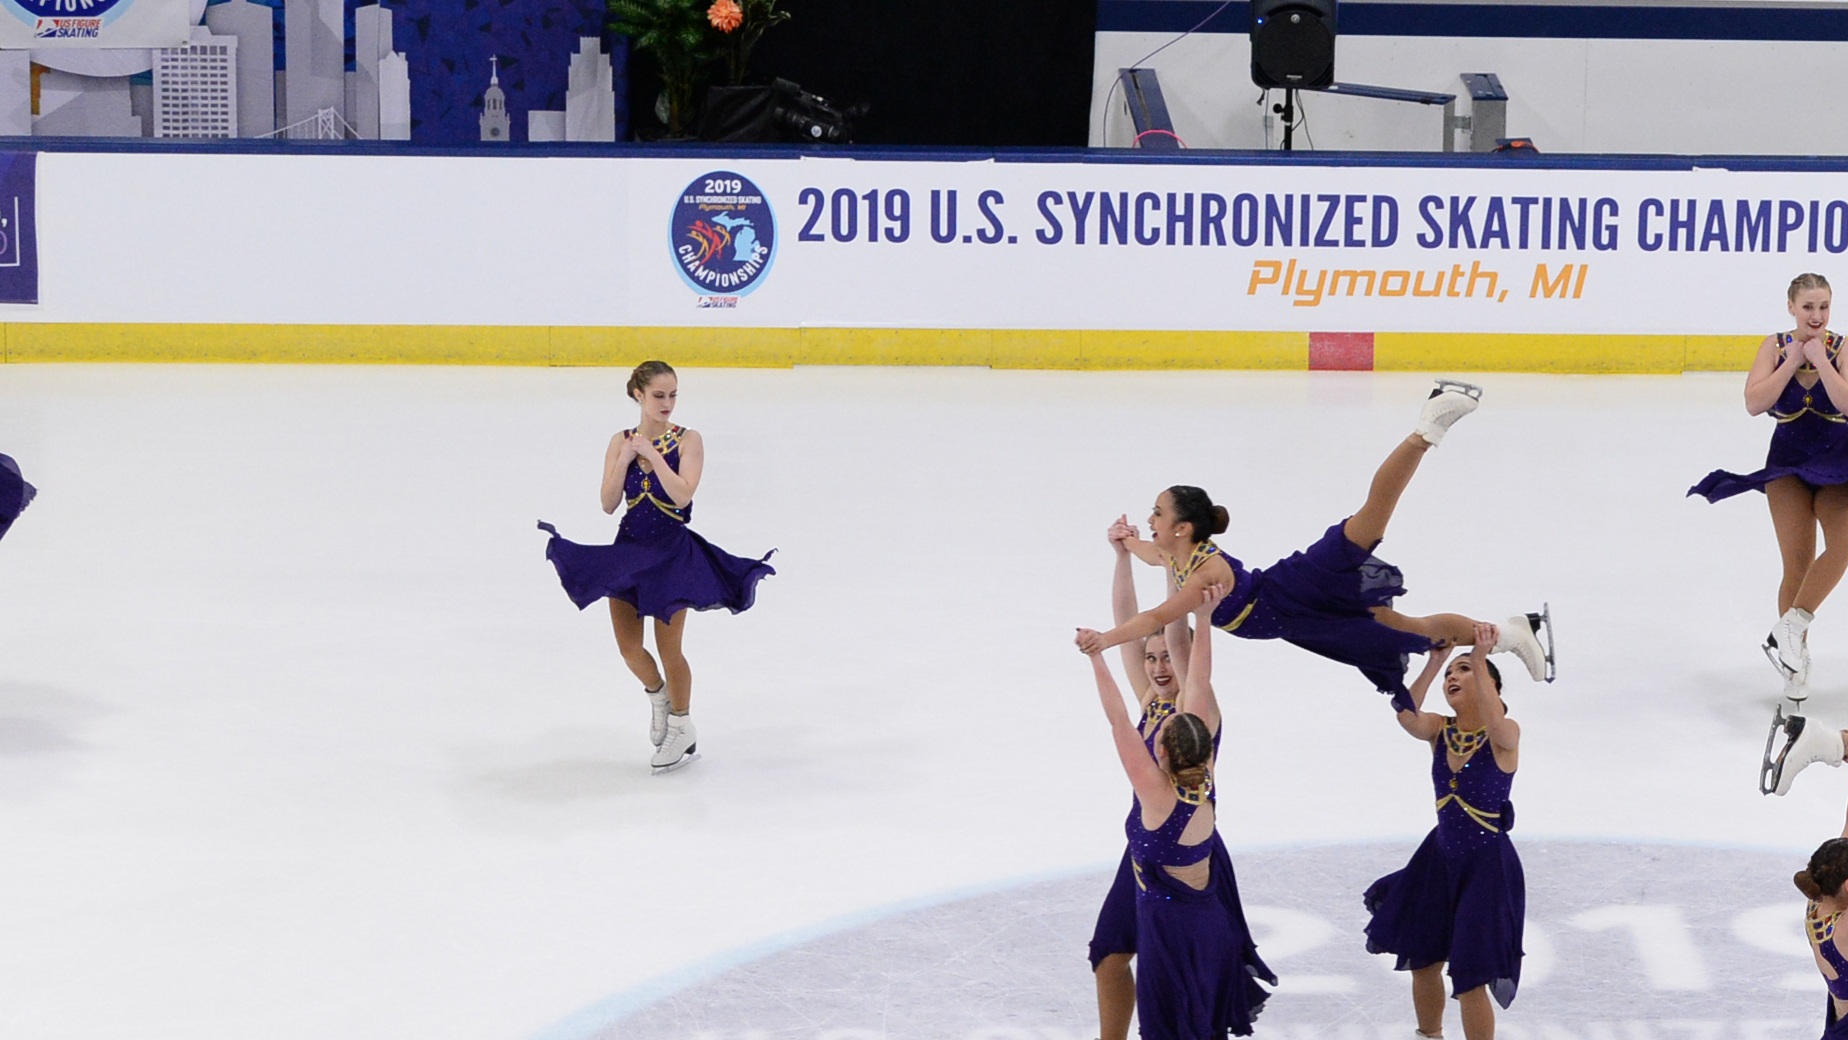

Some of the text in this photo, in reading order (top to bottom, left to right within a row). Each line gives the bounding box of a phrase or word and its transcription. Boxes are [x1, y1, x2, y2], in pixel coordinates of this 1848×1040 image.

[57, 28, 99, 38] SKATING
[59, 20, 102, 28] US FIGURE
[704, 179, 742, 194] 2019
[798, 187, 911, 243] 2019
[930, 189, 1018, 245] U.S.
[1034, 190, 1399, 249] SYNCHRONIZED
[1416, 194, 1619, 251] SKATING
[678, 244, 769, 288] CHAMPIONSHIPS
[1247, 258, 1589, 307] Plymouth, MI
